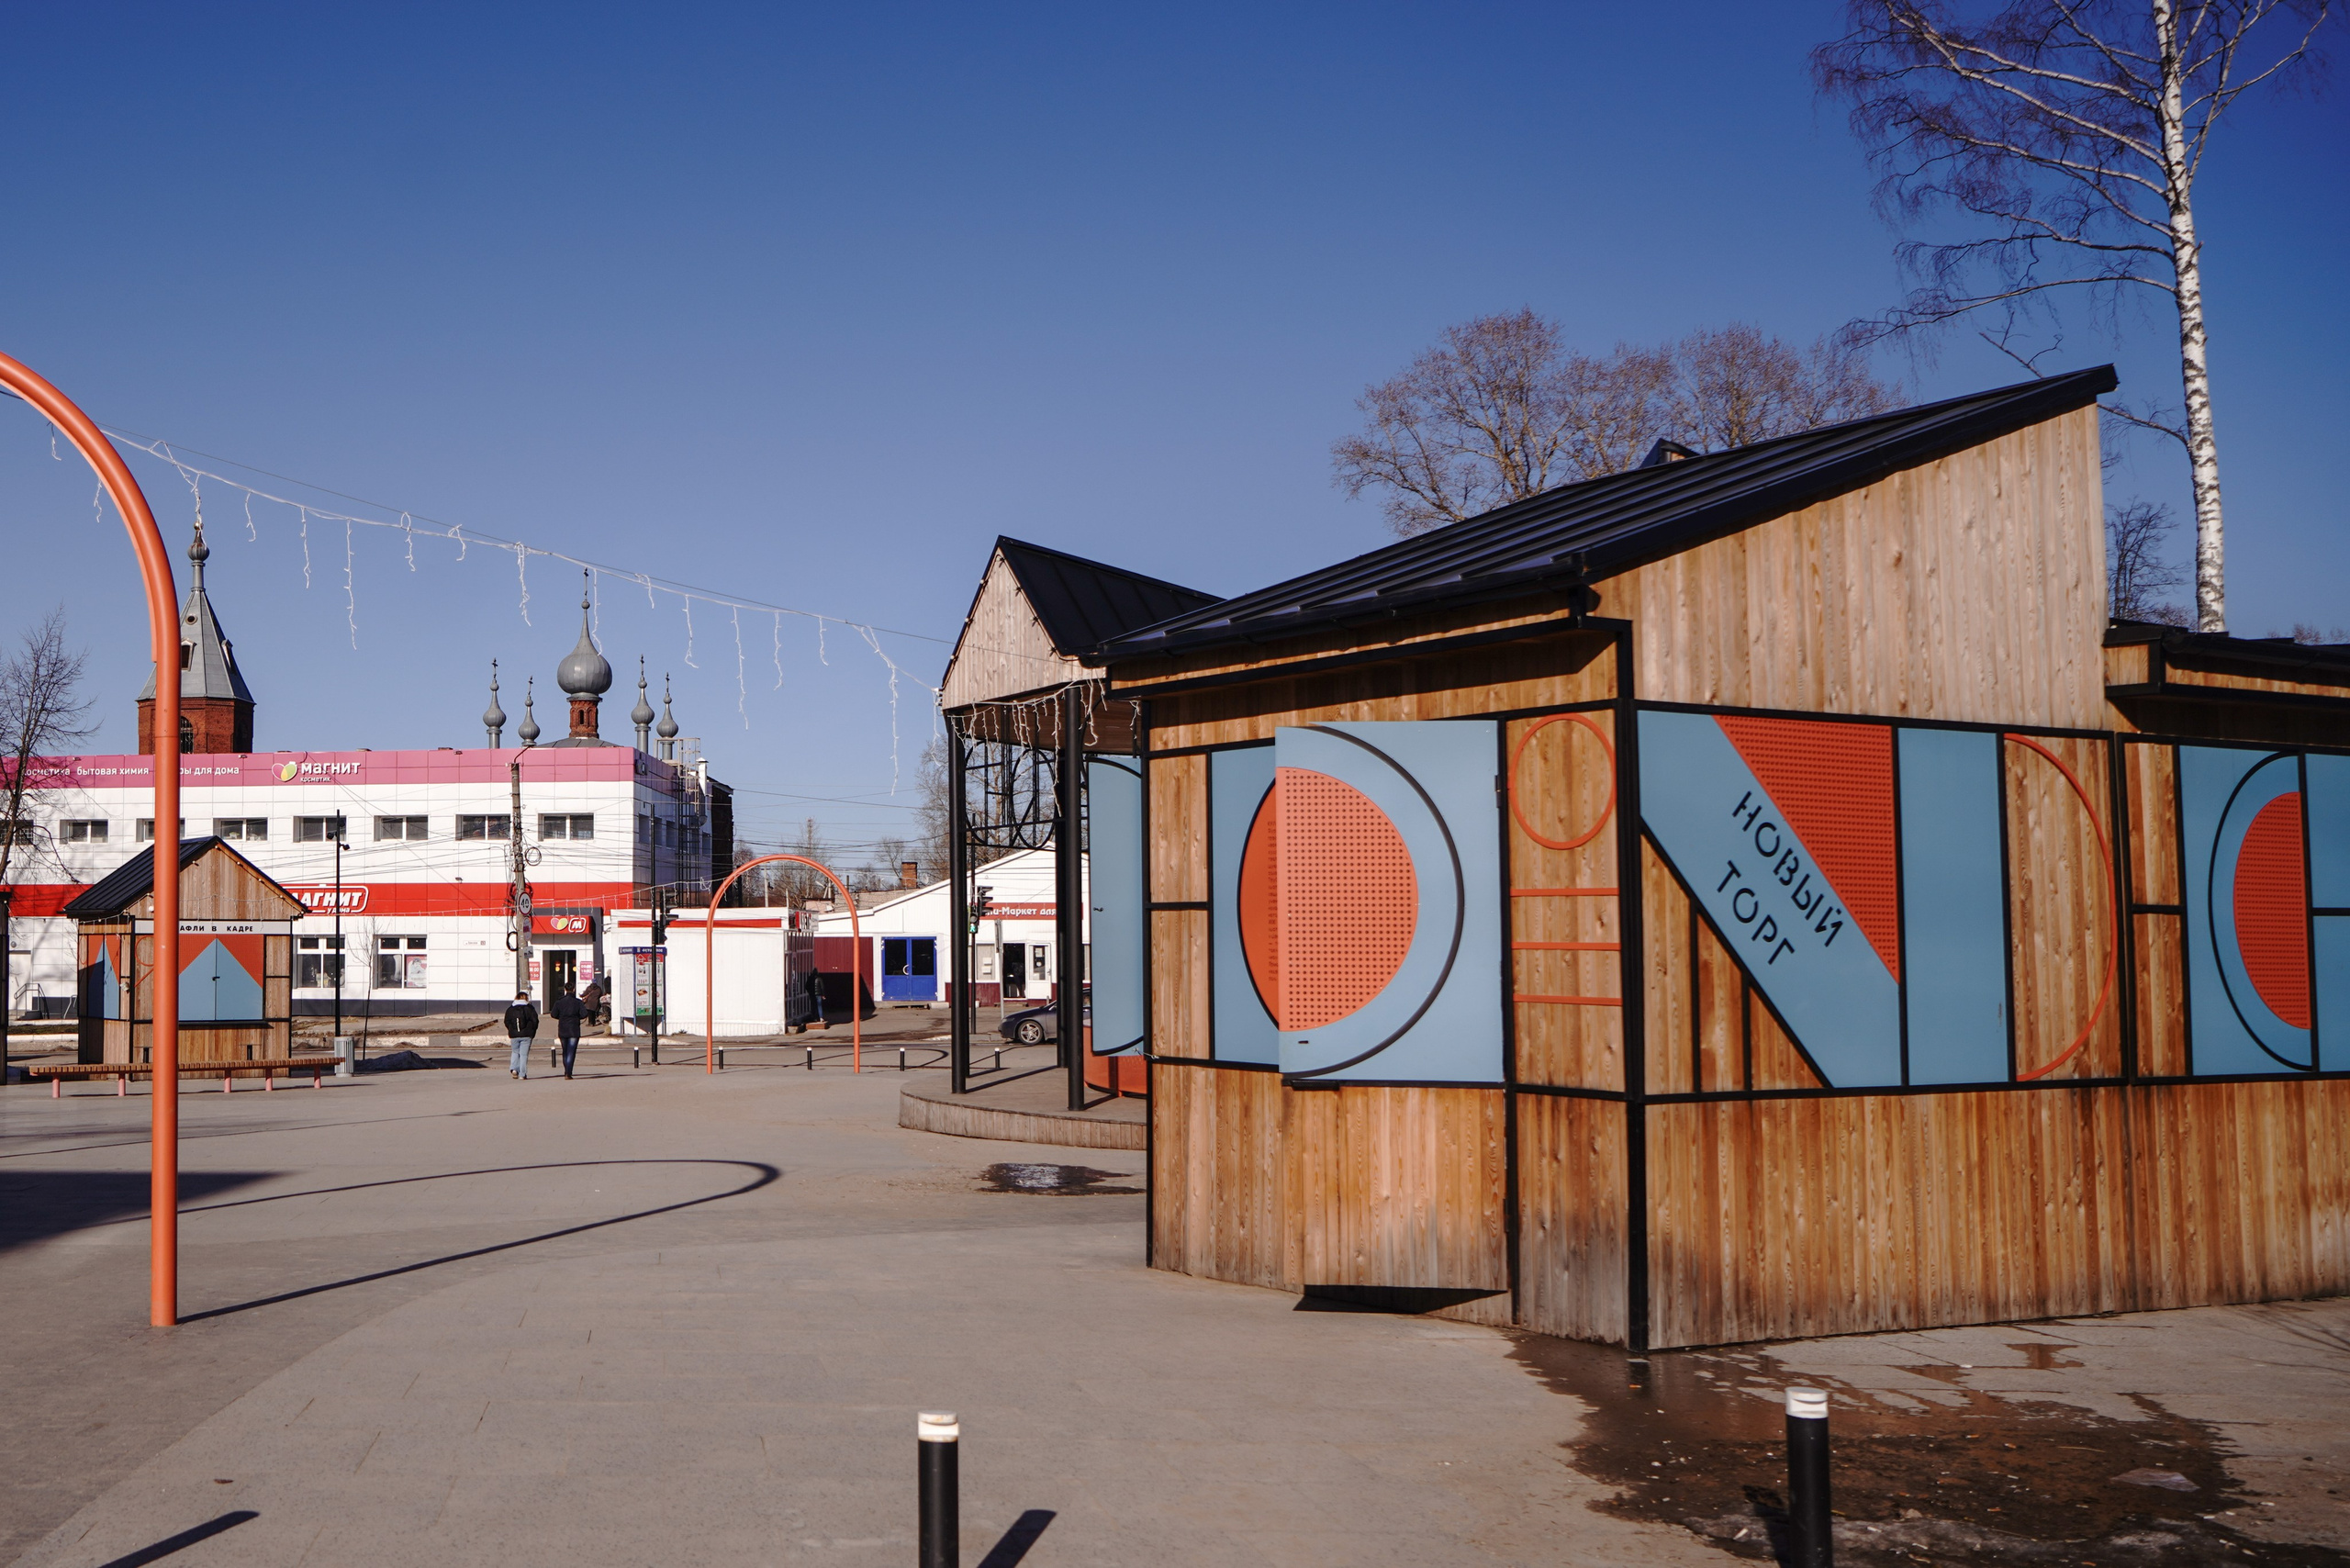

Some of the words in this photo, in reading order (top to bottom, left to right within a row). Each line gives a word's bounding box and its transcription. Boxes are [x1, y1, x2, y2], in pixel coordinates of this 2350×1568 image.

[25, 767, 71, 776] осметика
[76, 766, 118, 776] бытовая
[194, 767, 212, 776] для
[215, 767, 240, 775] дома
[1731, 790, 1844, 948] НОВЫЙ
[521, 898, 530, 909] 40
[985, 906, 1037, 917] и-Маркет
[1039, 908, 1057, 916] для
[1716, 859, 1796, 966] ТОРГ
